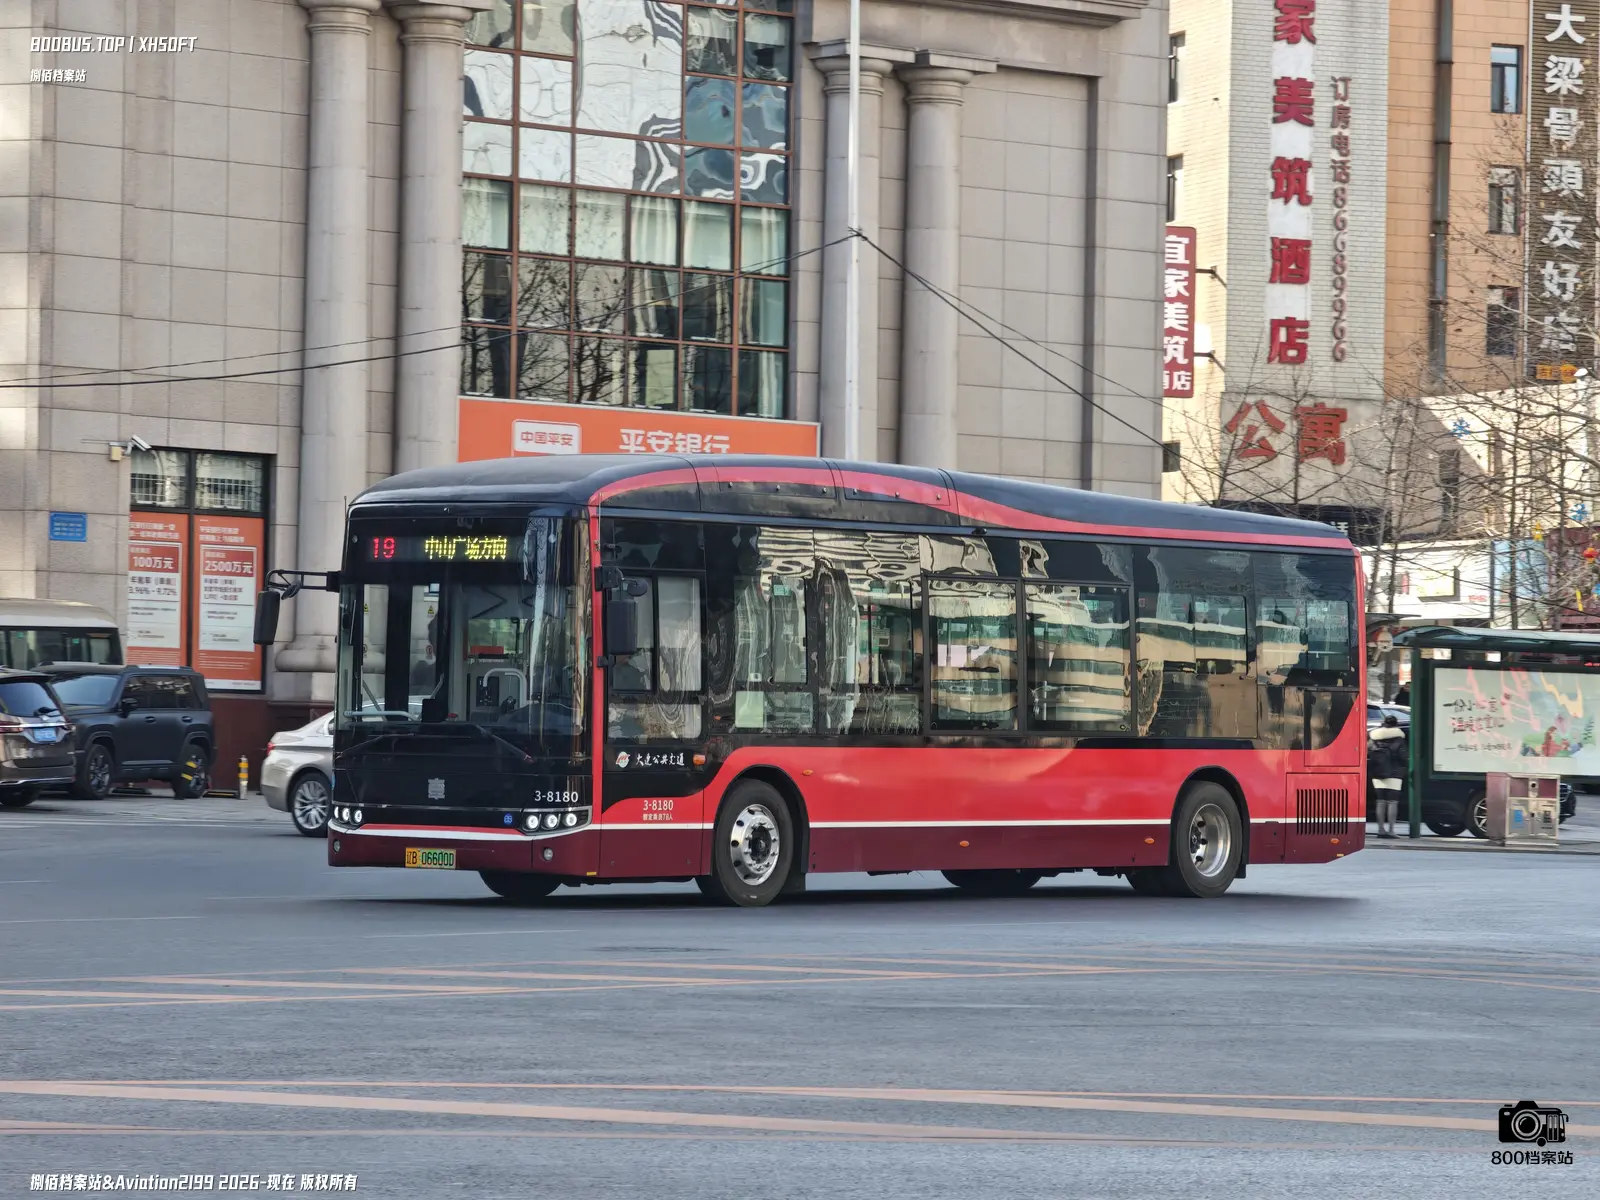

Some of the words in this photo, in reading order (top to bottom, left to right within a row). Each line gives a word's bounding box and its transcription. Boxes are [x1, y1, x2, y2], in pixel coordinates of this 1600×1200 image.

[1268, 0, 1317, 365] 家美筑酒店
[1163, 234, 1190, 365] 宜家美筑
[520, 430, 574, 447] 中国平安
[618, 427, 731, 455] 平安银行
[1224, 398, 1348, 466] 公寓
[372, 537, 395, 559] 19
[425, 535, 507, 560] 中山广场方向
[132, 556, 175, 570] 100万元
[204, 560, 254, 574] 2500万元
[635, 752, 685, 767] 大连公共交通
[534, 790, 579, 803] 3-8180
[643, 799, 674, 811] 3-8180
